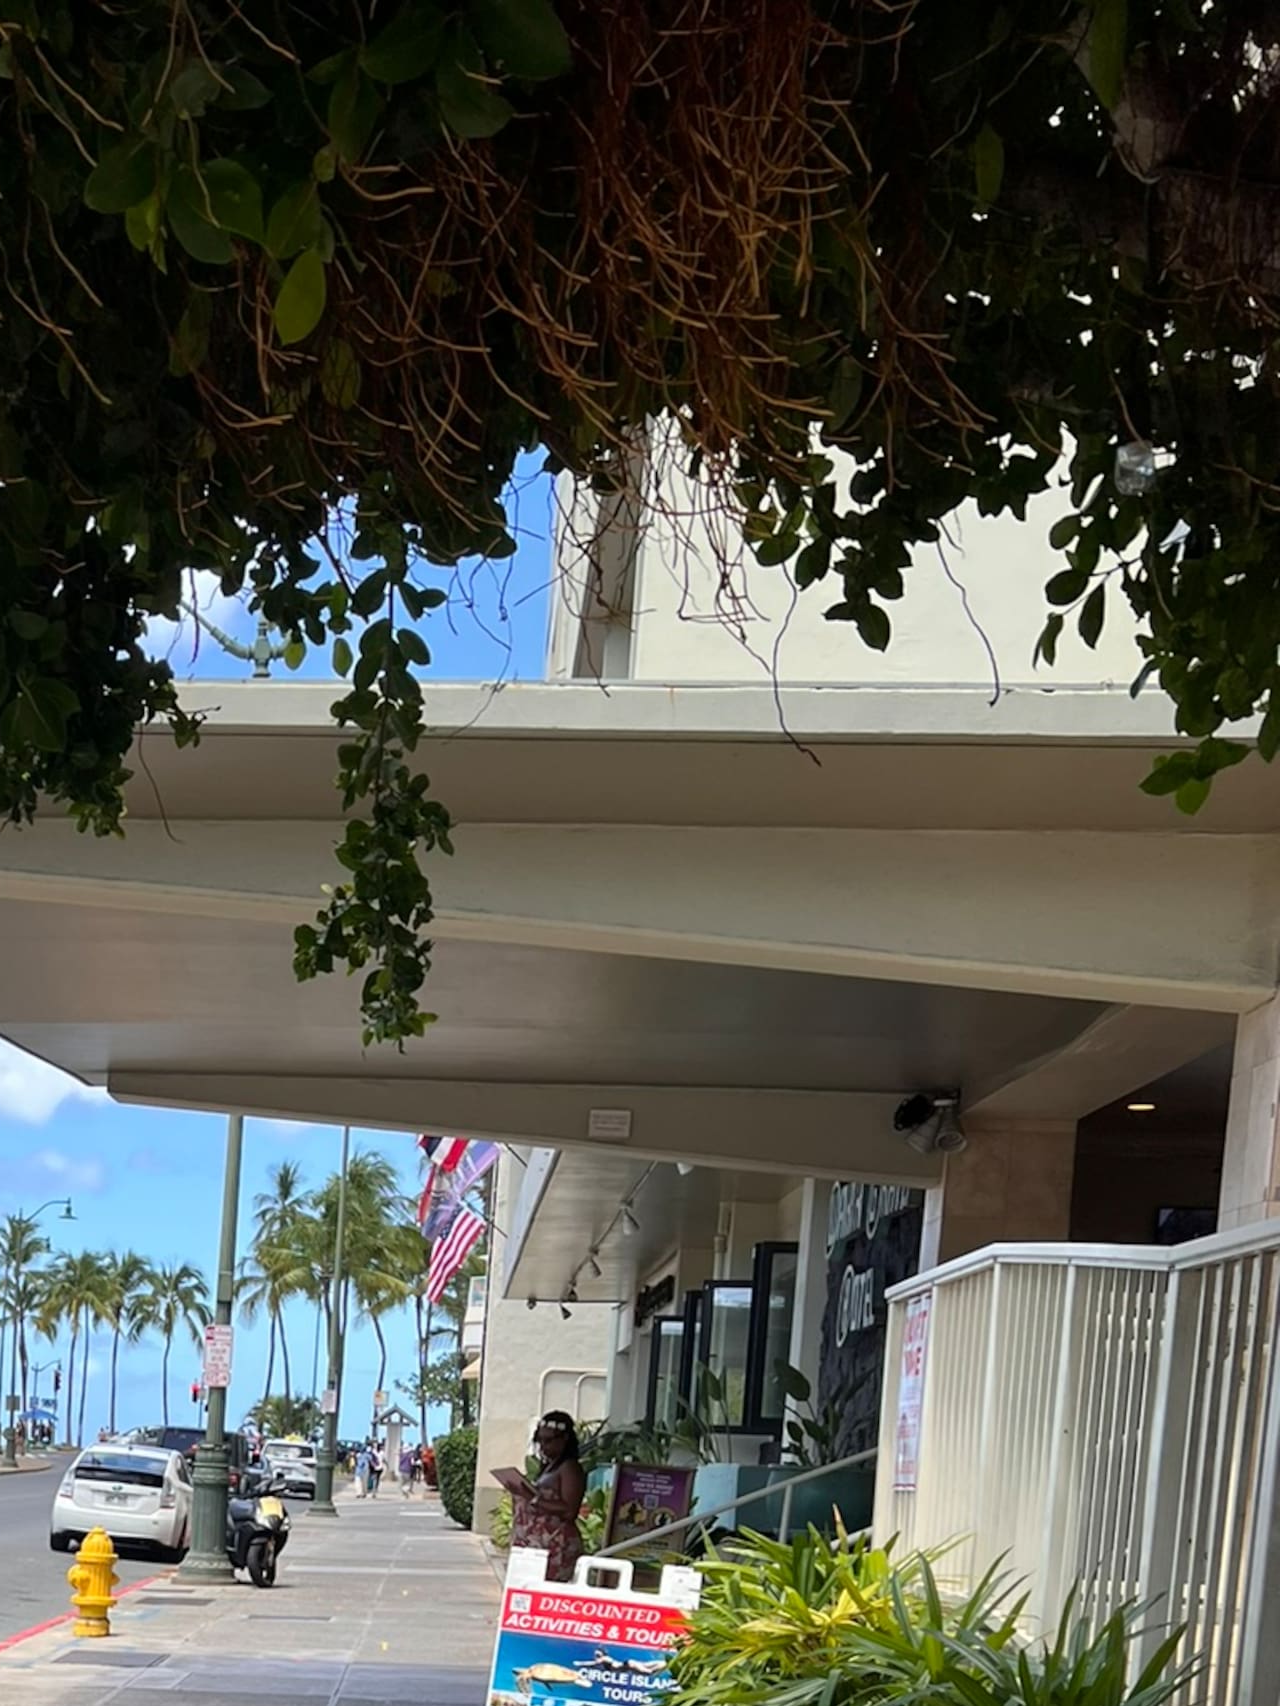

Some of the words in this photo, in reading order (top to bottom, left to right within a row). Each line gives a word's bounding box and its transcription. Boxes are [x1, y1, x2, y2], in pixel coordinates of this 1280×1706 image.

[539, 1597, 661, 1624] DISCOUNTED
[505, 1613, 602, 1637] ACTIVITIES
[606, 1625, 620, 1640] &
[578, 1667, 628, 1686] CIRCLE
